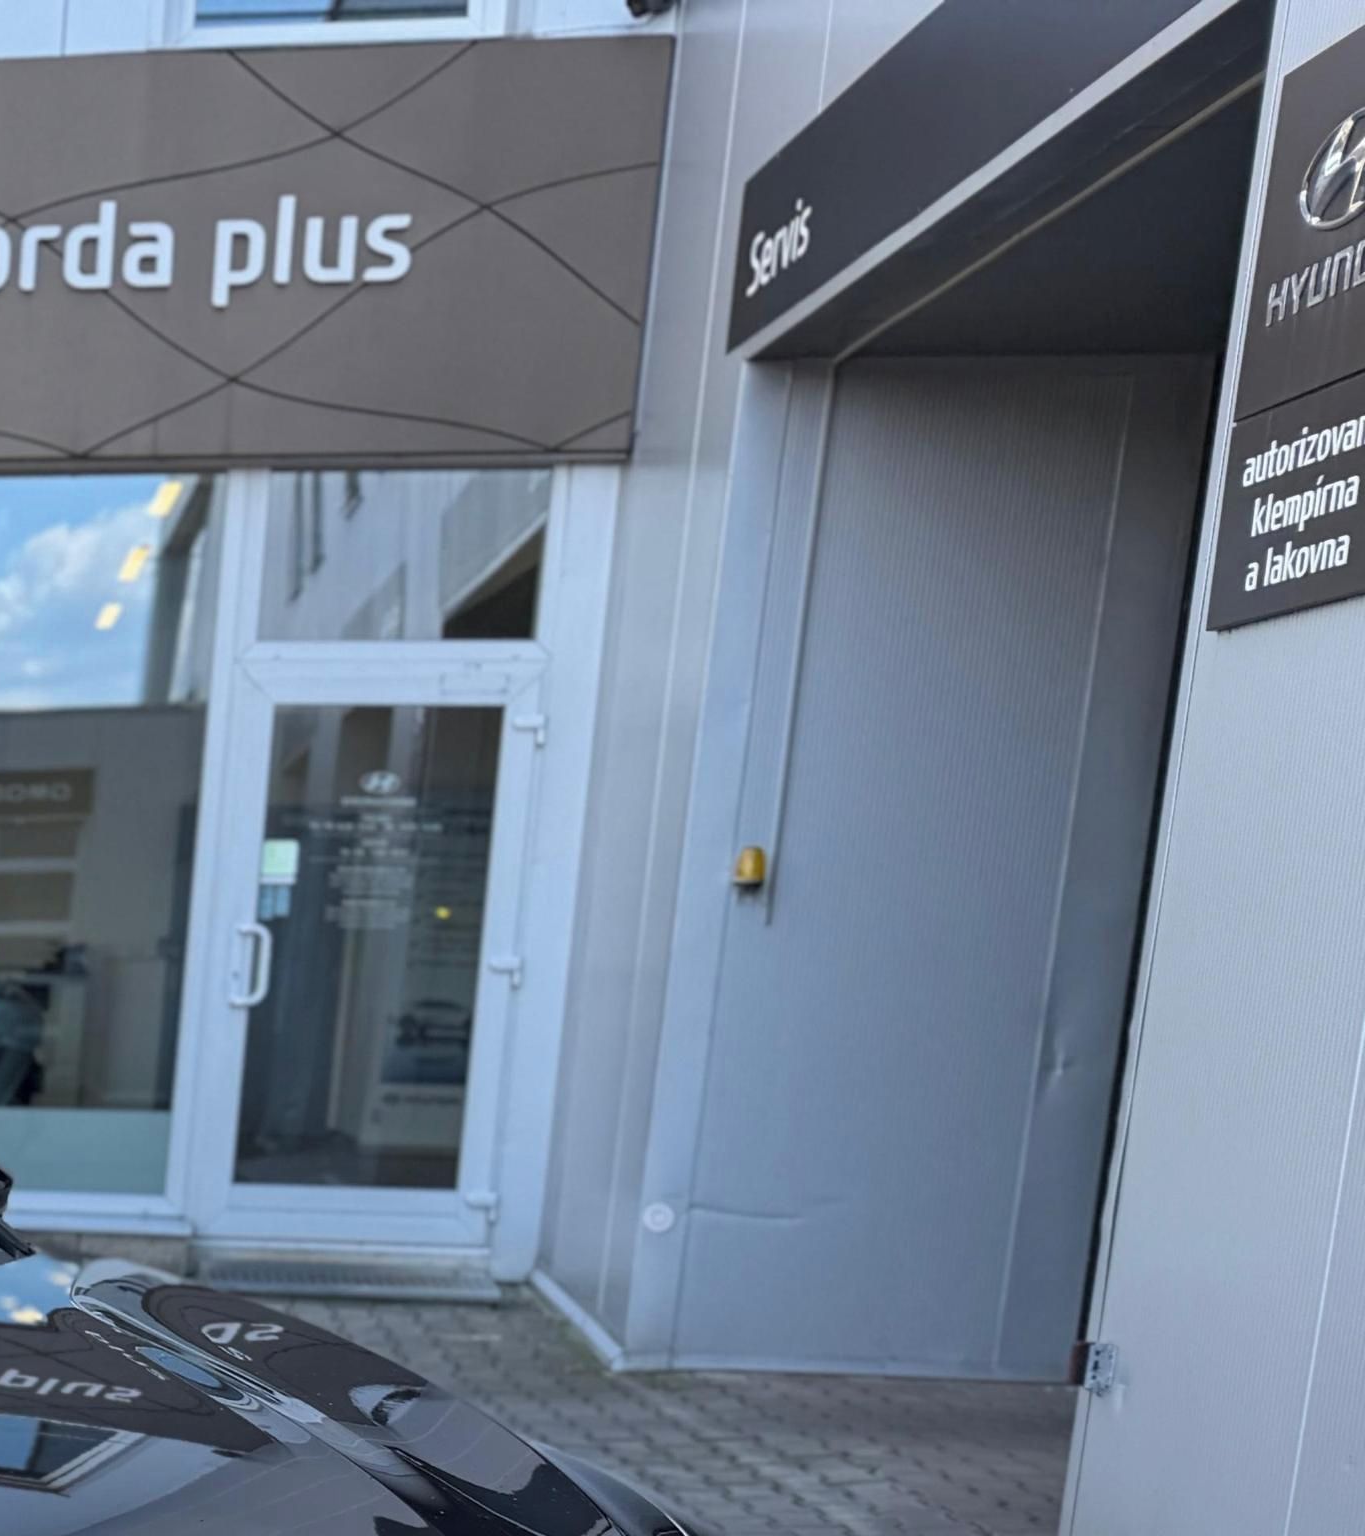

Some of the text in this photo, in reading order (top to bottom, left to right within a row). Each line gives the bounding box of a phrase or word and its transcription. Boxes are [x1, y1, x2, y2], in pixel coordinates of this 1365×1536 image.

[210, 194, 414, 308] plus
[744, 197, 813, 298] Servis
[1250, 474, 1360, 538] klempírna
[1244, 534, 1350, 592] a lakovna
